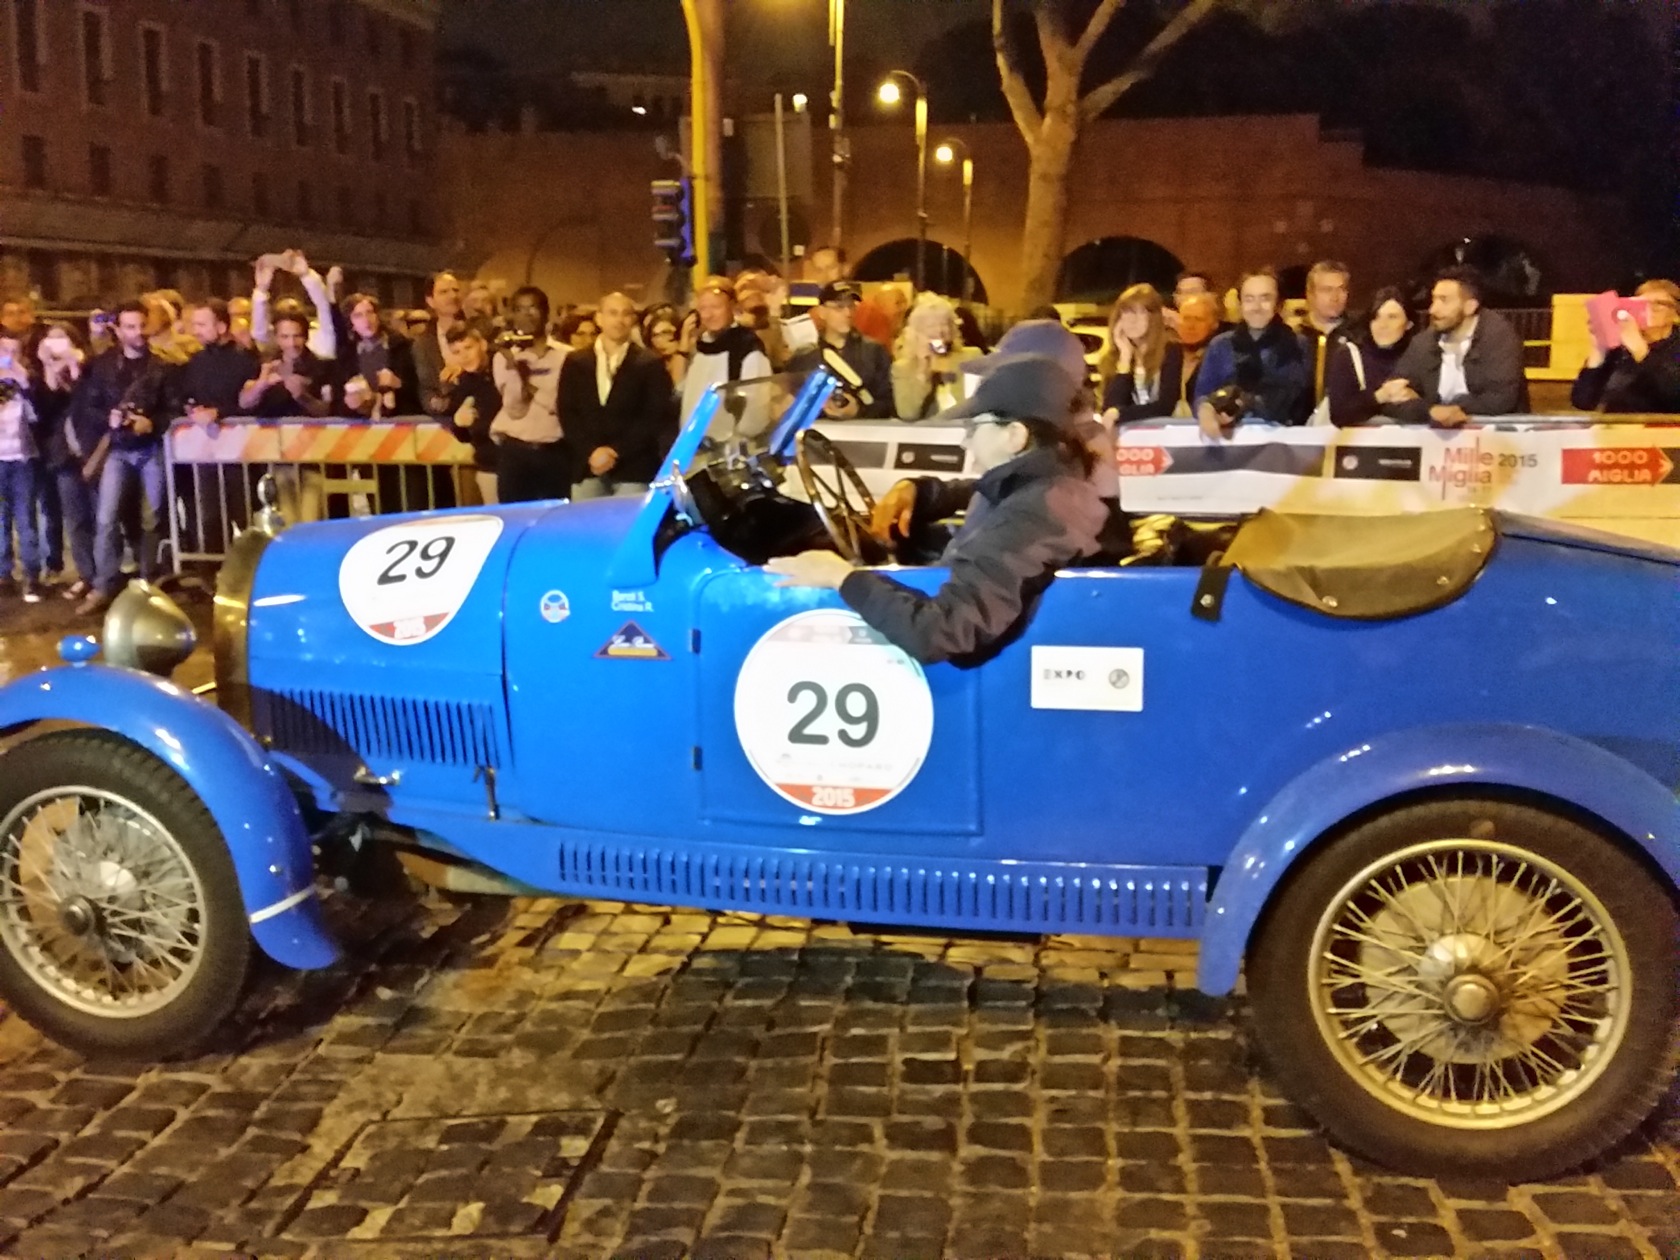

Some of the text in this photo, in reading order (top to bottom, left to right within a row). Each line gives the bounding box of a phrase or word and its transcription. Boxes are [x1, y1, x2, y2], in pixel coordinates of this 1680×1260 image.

[1116, 448, 1155, 462] 000
[1444, 437, 1538, 468] Mille 2015
[1592, 450, 1648, 465] 1000
[1118, 463, 1156, 476] GLIA
[1429, 465, 1492, 500] Miglia
[376, 536, 456, 586] 29
[787, 680, 880, 749] 29
[811, 786, 856, 808] 2015
